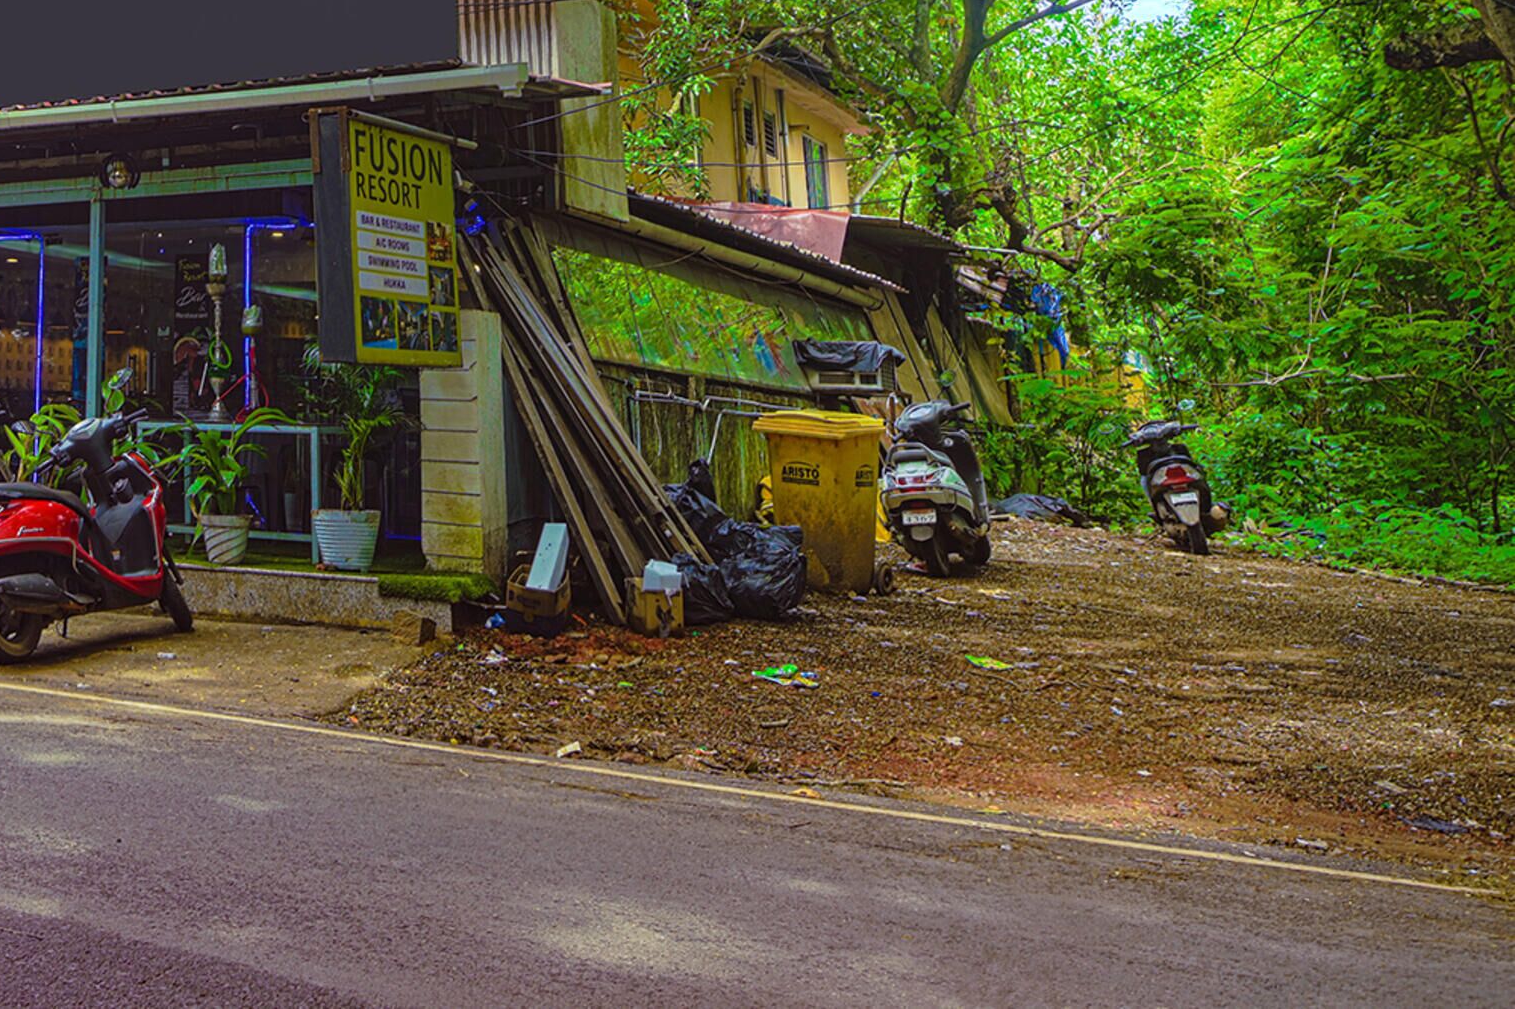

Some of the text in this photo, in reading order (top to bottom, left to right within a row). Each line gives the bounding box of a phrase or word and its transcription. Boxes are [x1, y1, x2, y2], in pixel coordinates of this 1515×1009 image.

[354, 129, 443, 186] FUSION
[356, 172, 422, 209] RESORT
[361, 214, 374, 225] BAR
[382, 218, 421, 233] RESTAURANT
[388, 238, 410, 252] ROOMS
[368, 255, 418, 272] SWIMMING POOL
[782, 464, 820, 480] ARISTO
